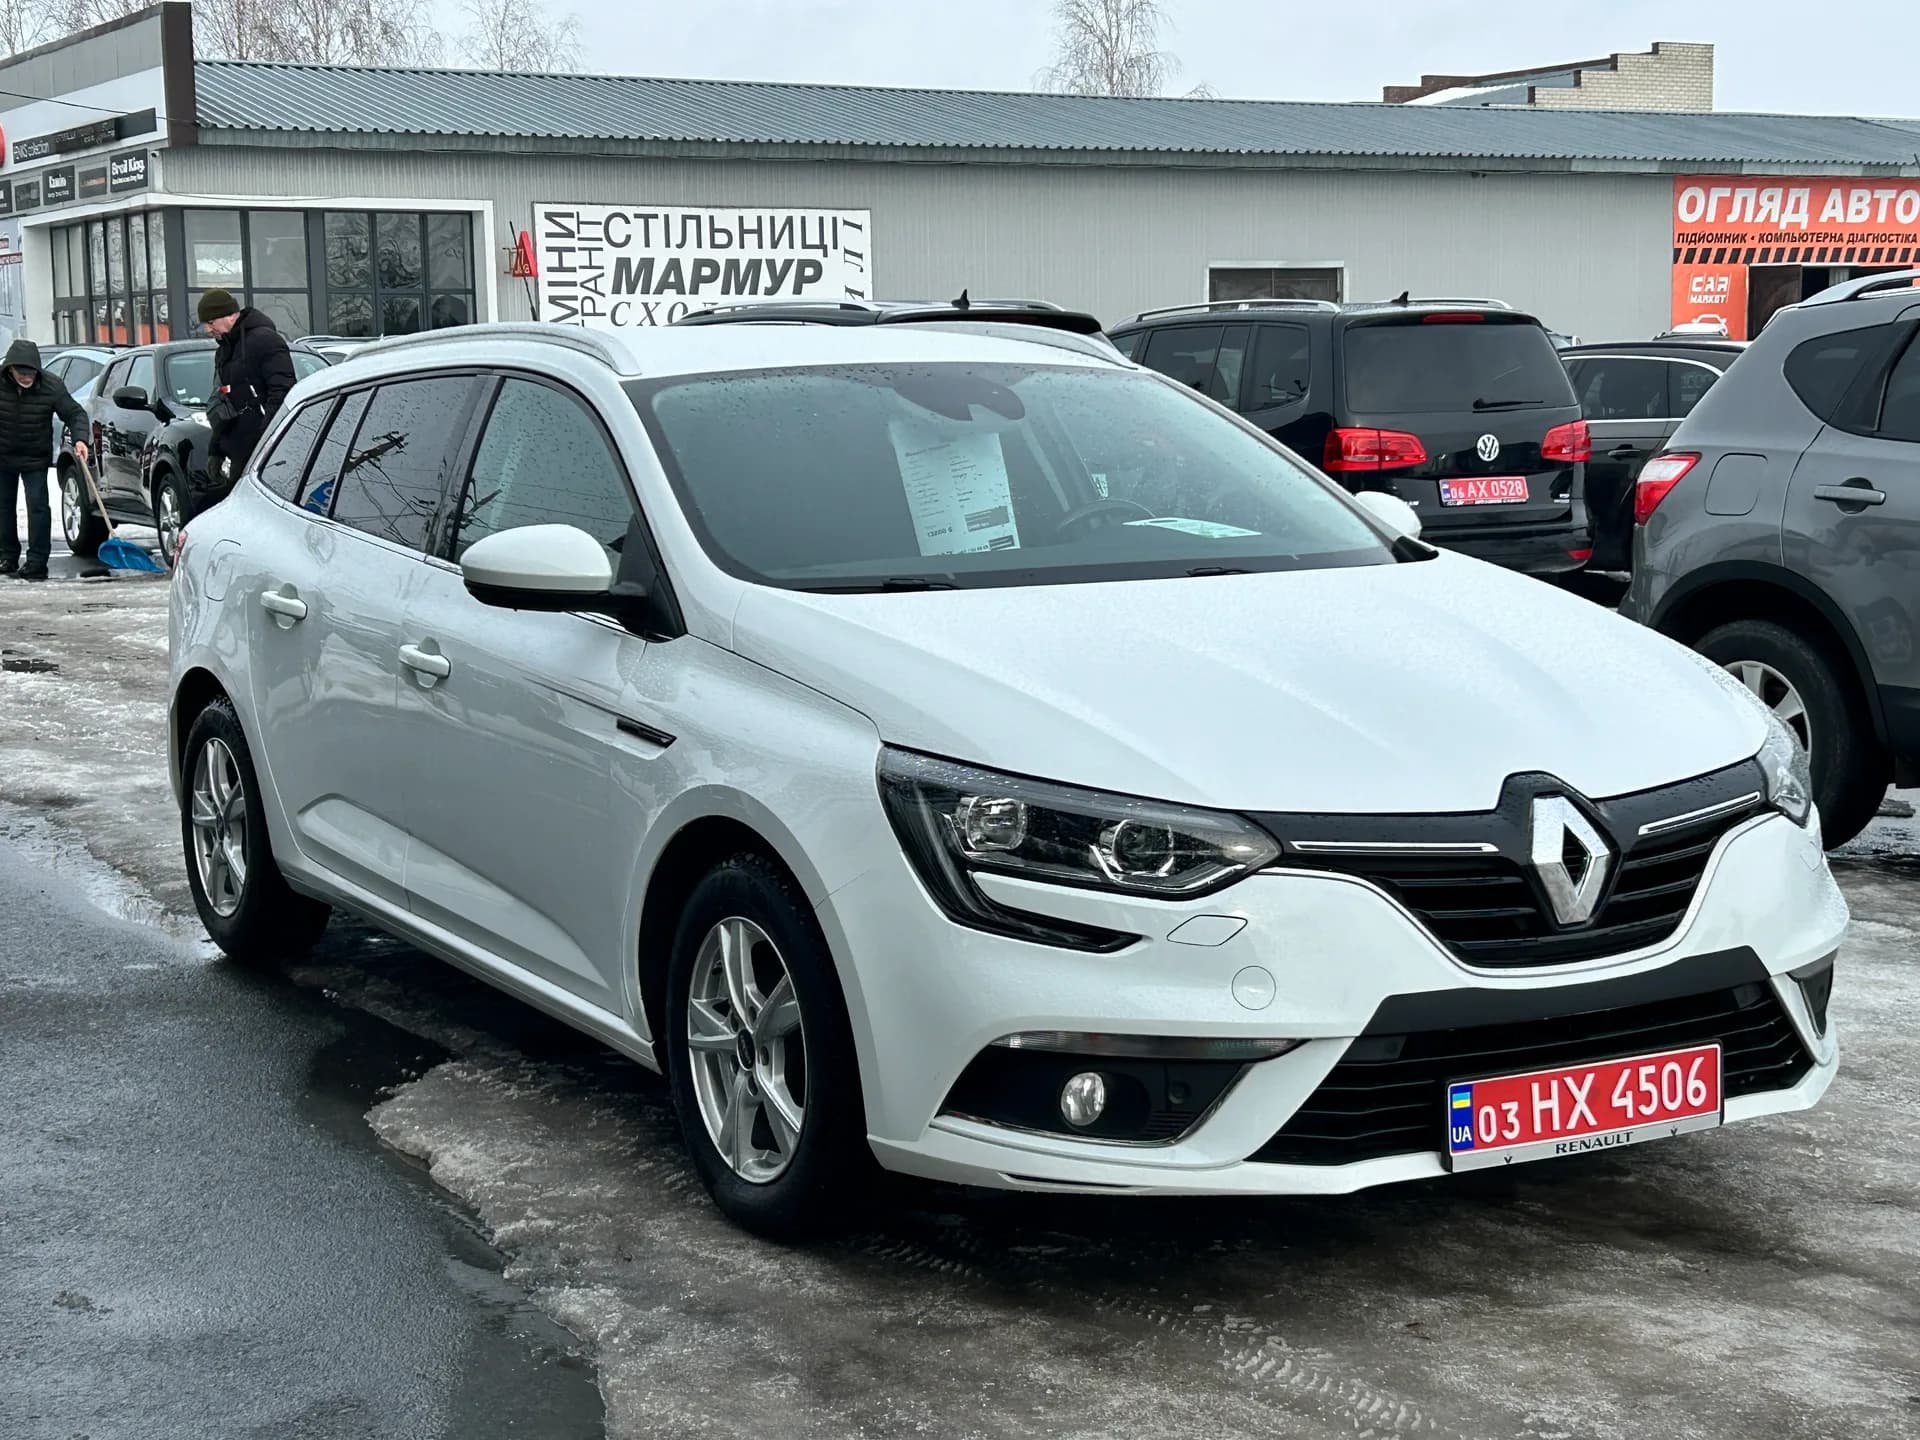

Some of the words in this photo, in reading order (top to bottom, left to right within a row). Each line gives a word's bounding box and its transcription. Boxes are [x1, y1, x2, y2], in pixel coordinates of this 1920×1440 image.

[1677, 186, 1811, 230] ОГЛЯД
[1818, 188, 1920, 225] АВТО
[603, 211, 839, 258] СТІЛЬНИЦІ
[1676, 231, 1748, 244] ПІДЙОМНИК
[611, 256, 823, 296] МАРМУР
[1690, 275, 1729, 293] CAR
[1689, 294, 1727, 304] MARKET
[1467, 481, 1488, 498] AX
[1490, 480, 1524, 496] 0528
[1478, 1101, 1520, 1144] 03
[1531, 1073, 1598, 1134] HX
[1611, 1057, 1707, 1119] 4506
[1452, 1127, 1472, 1144] UA
[1555, 1131, 1633, 1155] RENAULT
